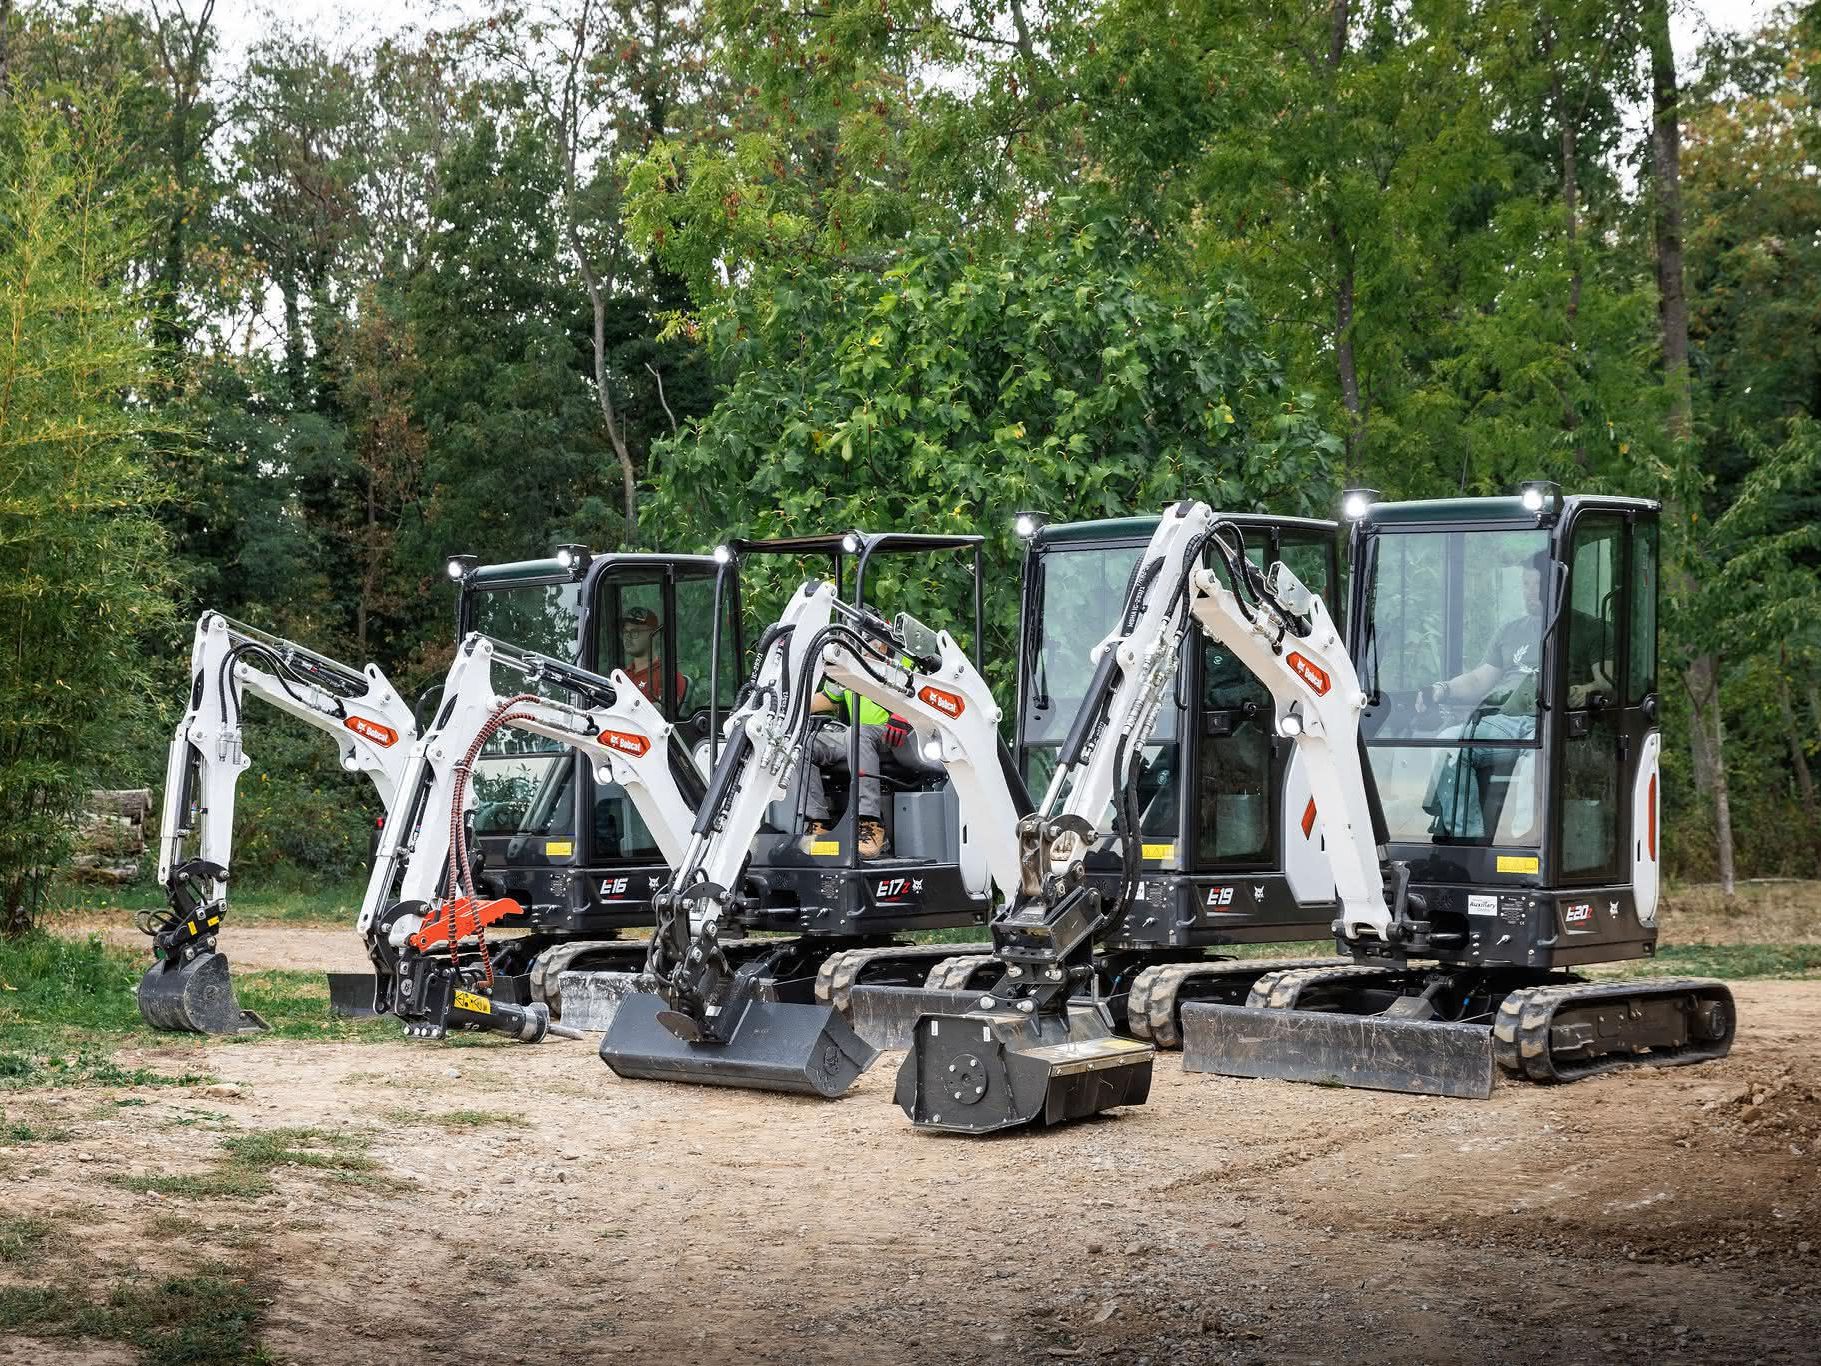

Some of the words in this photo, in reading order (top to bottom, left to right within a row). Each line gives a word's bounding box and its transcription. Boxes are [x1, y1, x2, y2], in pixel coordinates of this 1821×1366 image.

[1304, 666, 1323, 690] Bobcat
[938, 696, 956, 713] Bobcat
[365, 726, 388, 743] Bobcat
[619, 737, 641, 752] Bobcat
[600, 877, 629, 895] E16
[1206, 887, 1234, 905] E19
